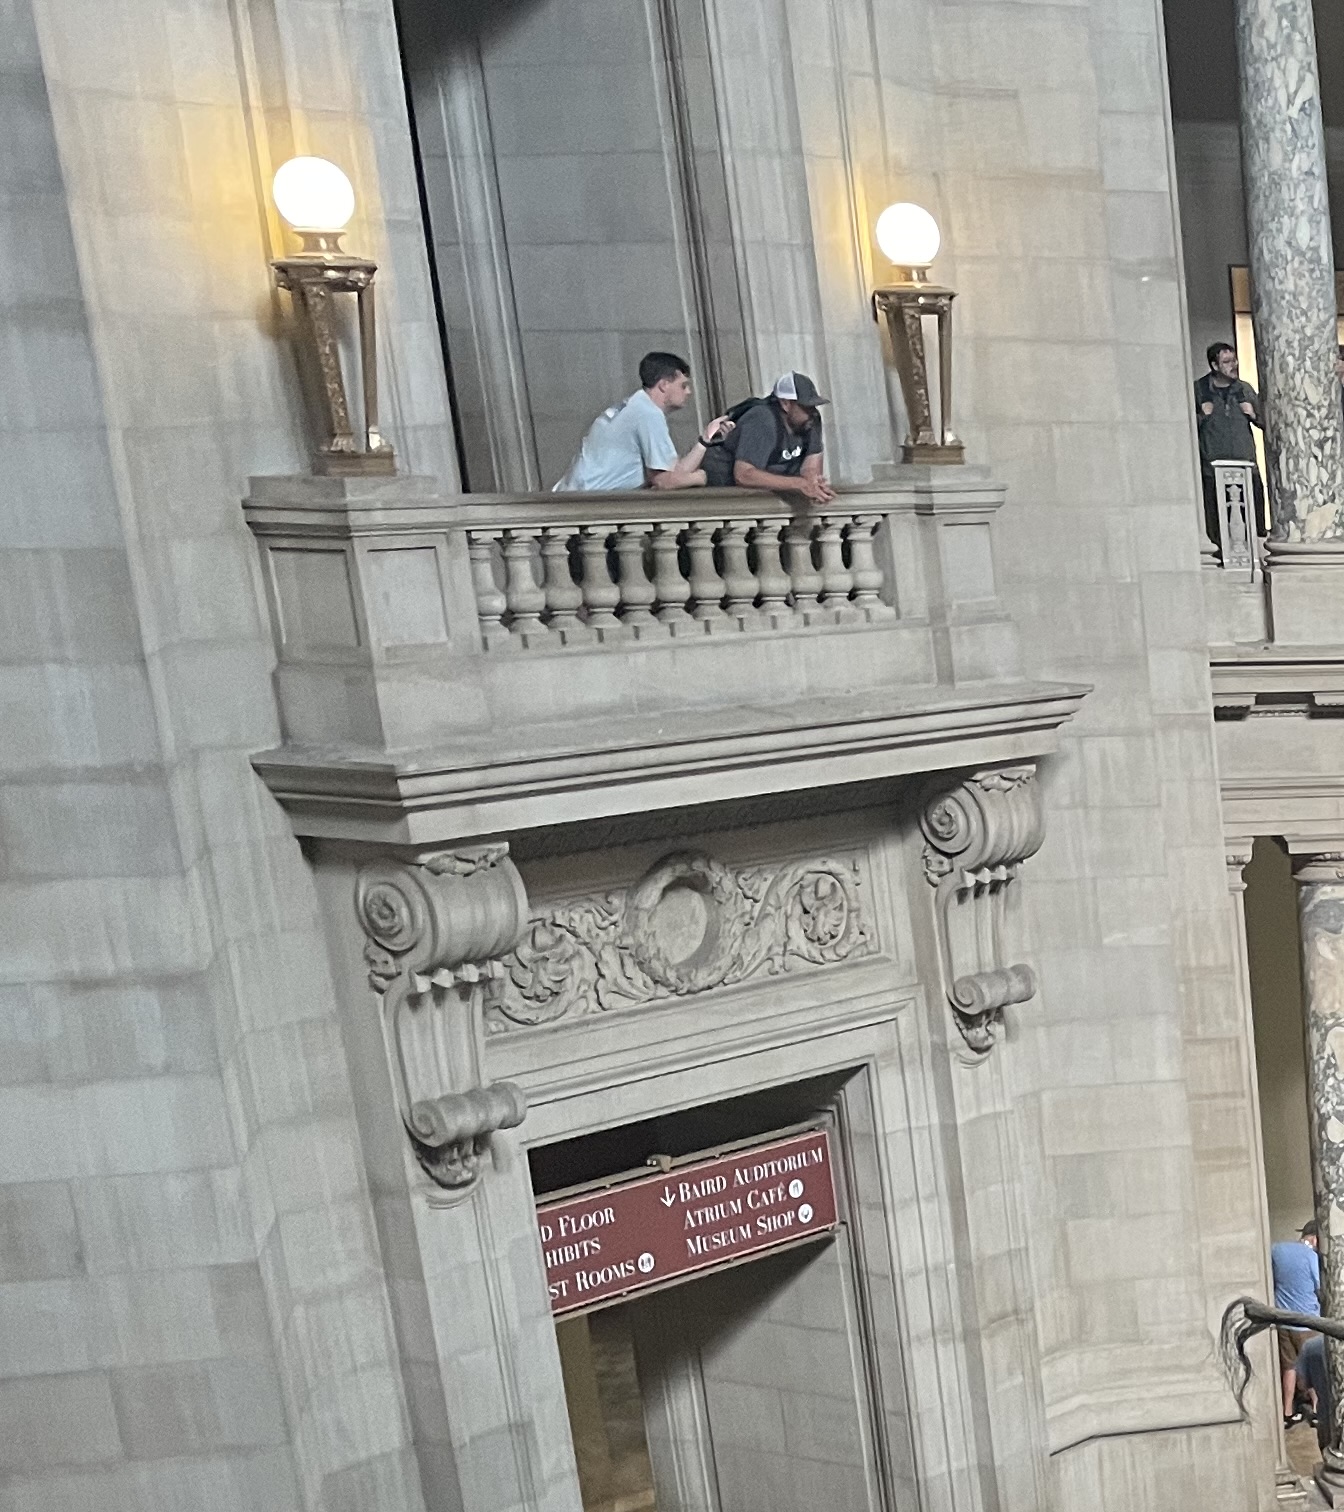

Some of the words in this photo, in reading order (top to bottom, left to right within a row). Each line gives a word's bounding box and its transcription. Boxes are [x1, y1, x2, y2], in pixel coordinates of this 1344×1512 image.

[678, 1175, 727, 1202] BAIRD
[733, 1147, 823, 1188] AUDITORIUM
[558, 1207, 615, 1237] FLOOR
[683, 1198, 742, 1230] ATRIUM
[686, 1223, 752, 1258] MUSEUM
[756, 1210, 795, 1236] SHOP
[546, 1237, 601, 1268] HIBITS
[548, 1280, 569, 1299] ST
[576, 1259, 636, 1292] ROOMS
